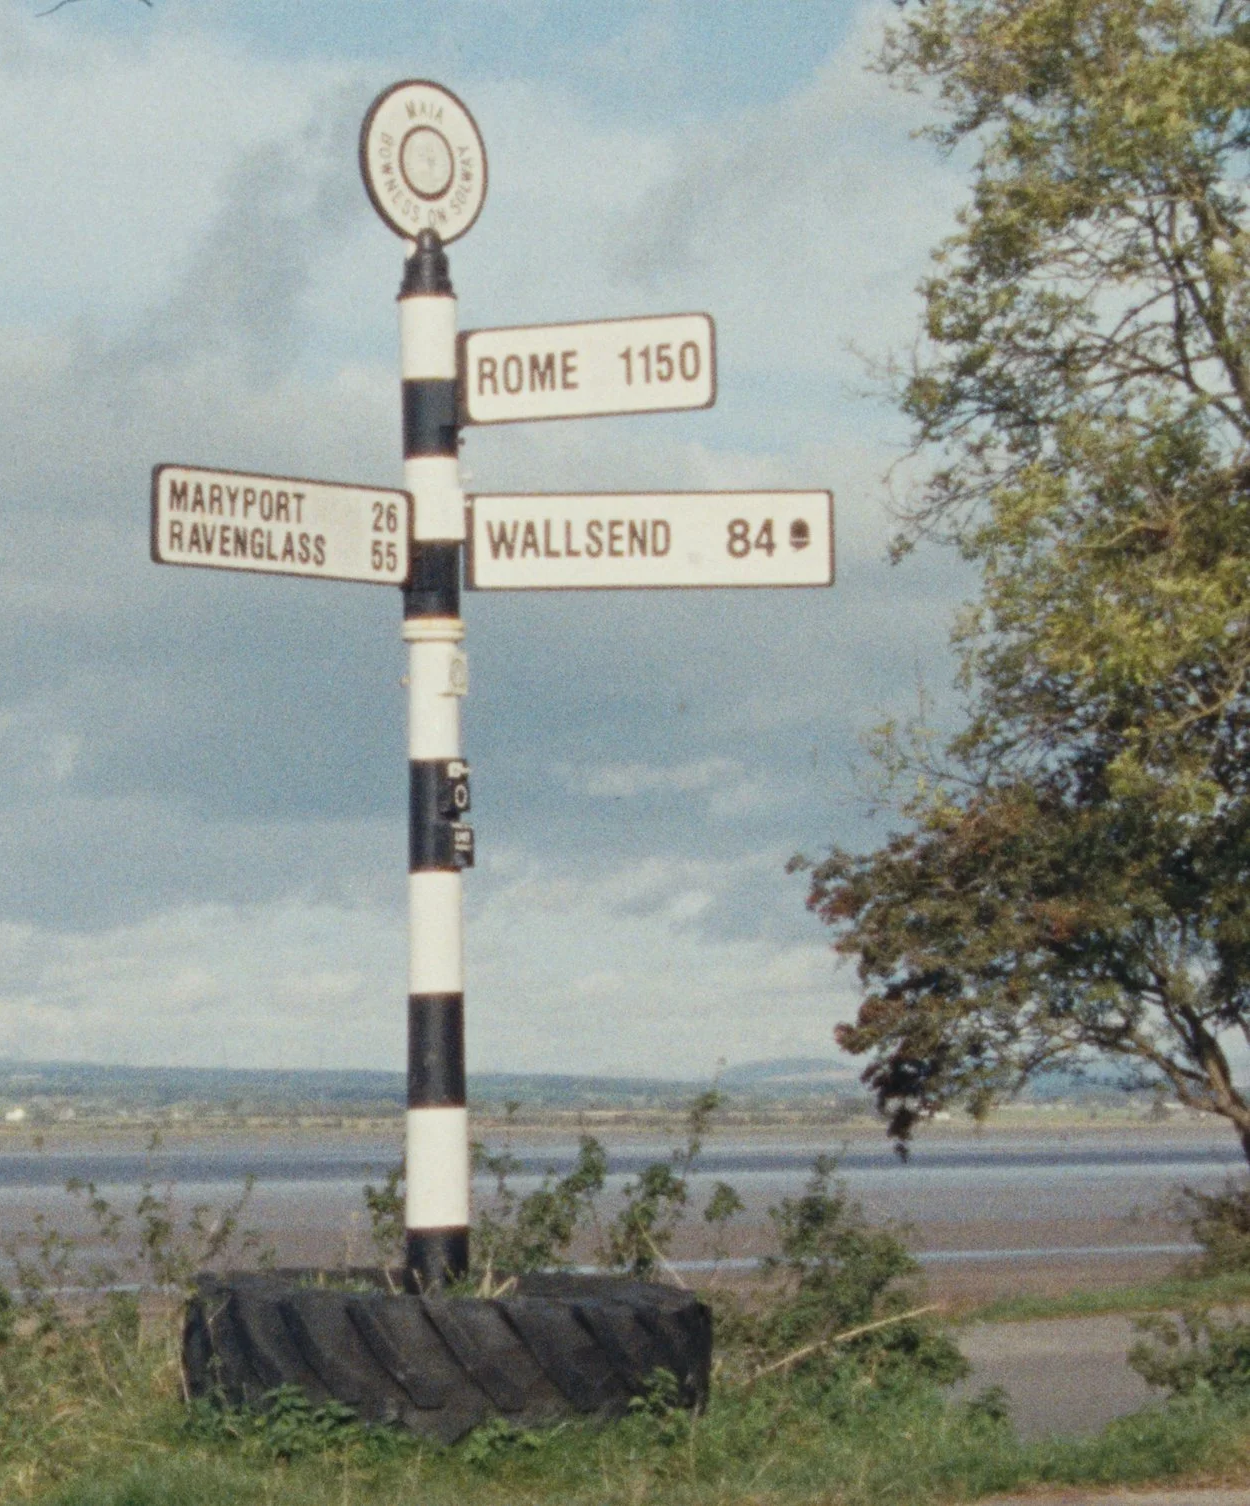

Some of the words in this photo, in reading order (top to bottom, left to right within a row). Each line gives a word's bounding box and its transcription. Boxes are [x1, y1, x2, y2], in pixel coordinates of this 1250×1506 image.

[404, 98, 444, 125] MAIA
[477, 349, 580, 396] ROME
[618, 340, 702, 387] 1150
[169, 479, 306, 525] MARYPORT
[371, 501, 398, 533] 26
[168, 519, 327, 567] RAVENGLASS
[370, 540, 398, 572] 55
[486, 518, 671, 560] WALLSEND
[725, 517, 777, 559] 84
